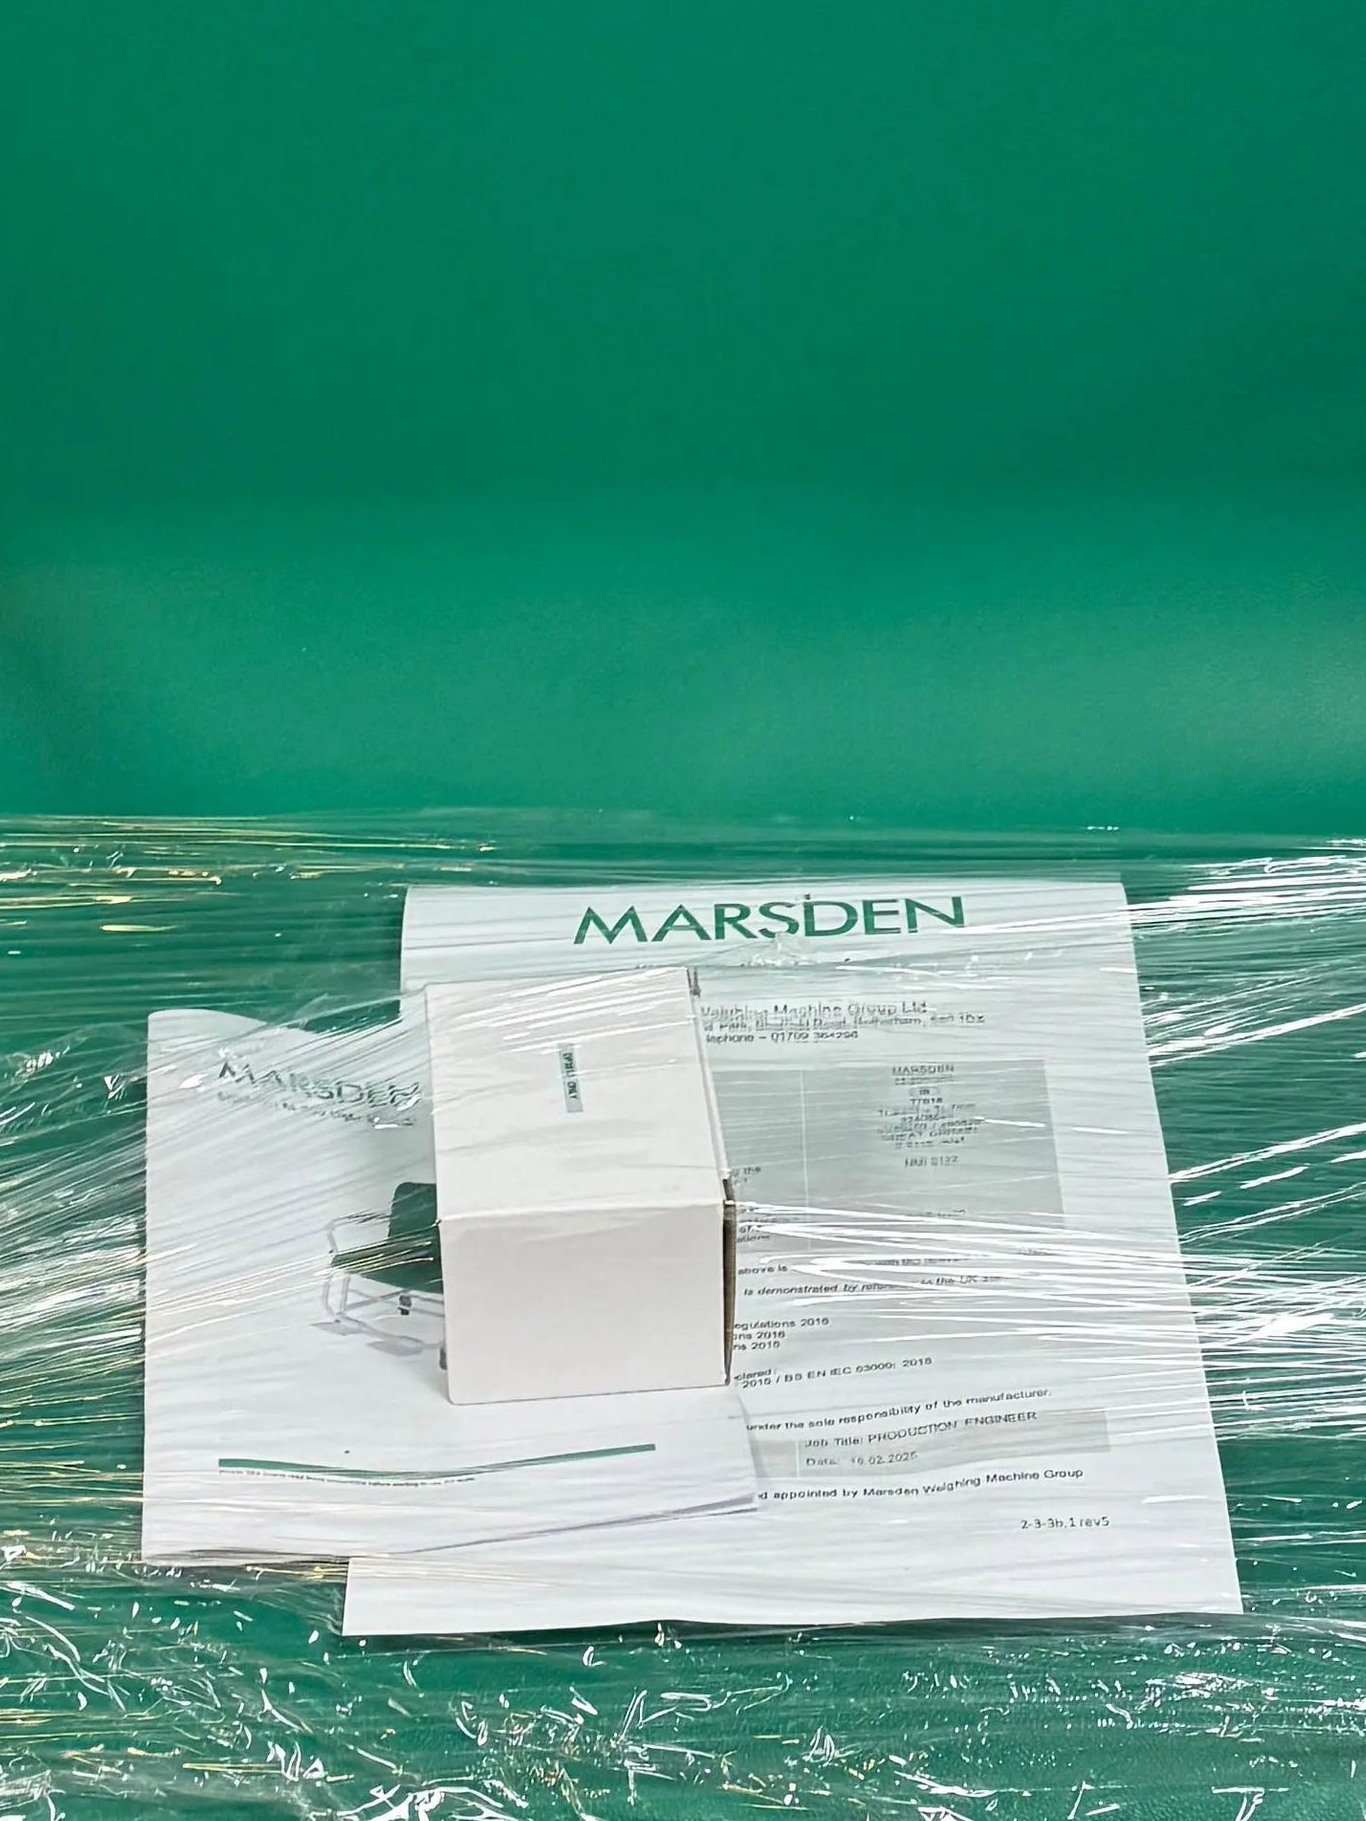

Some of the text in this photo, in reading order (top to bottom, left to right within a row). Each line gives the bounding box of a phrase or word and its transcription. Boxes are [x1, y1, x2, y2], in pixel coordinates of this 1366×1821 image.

[574, 896, 966, 945] MARSDEN
[706, 1033, 755, 1044] lephone
[757, 1284, 838, 1295] demonstrated
[843, 1284, 857, 1293] by
[734, 1320, 796, 1331] egulations
[807, 1369, 826, 1380] EN
[785, 1421, 805, 1430] the
[808, 1418, 835, 1429] sole
[838, 1404, 921, 1424] responsibility
[925, 1400, 938, 1411] of
[942, 1398, 963, 1409] the
[966, 1388, 1052, 1405] manufacturer.
[805, 1437, 828, 1448] Job
[868, 1419, 957, 1444] PRODUCTION
[964, 1411, 1037, 1427] ENGINEER
[773, 1468, 1084, 1500] appointed by Marsden Weighing Machine Group
[1079, 1515, 1111, 1528] rev5
